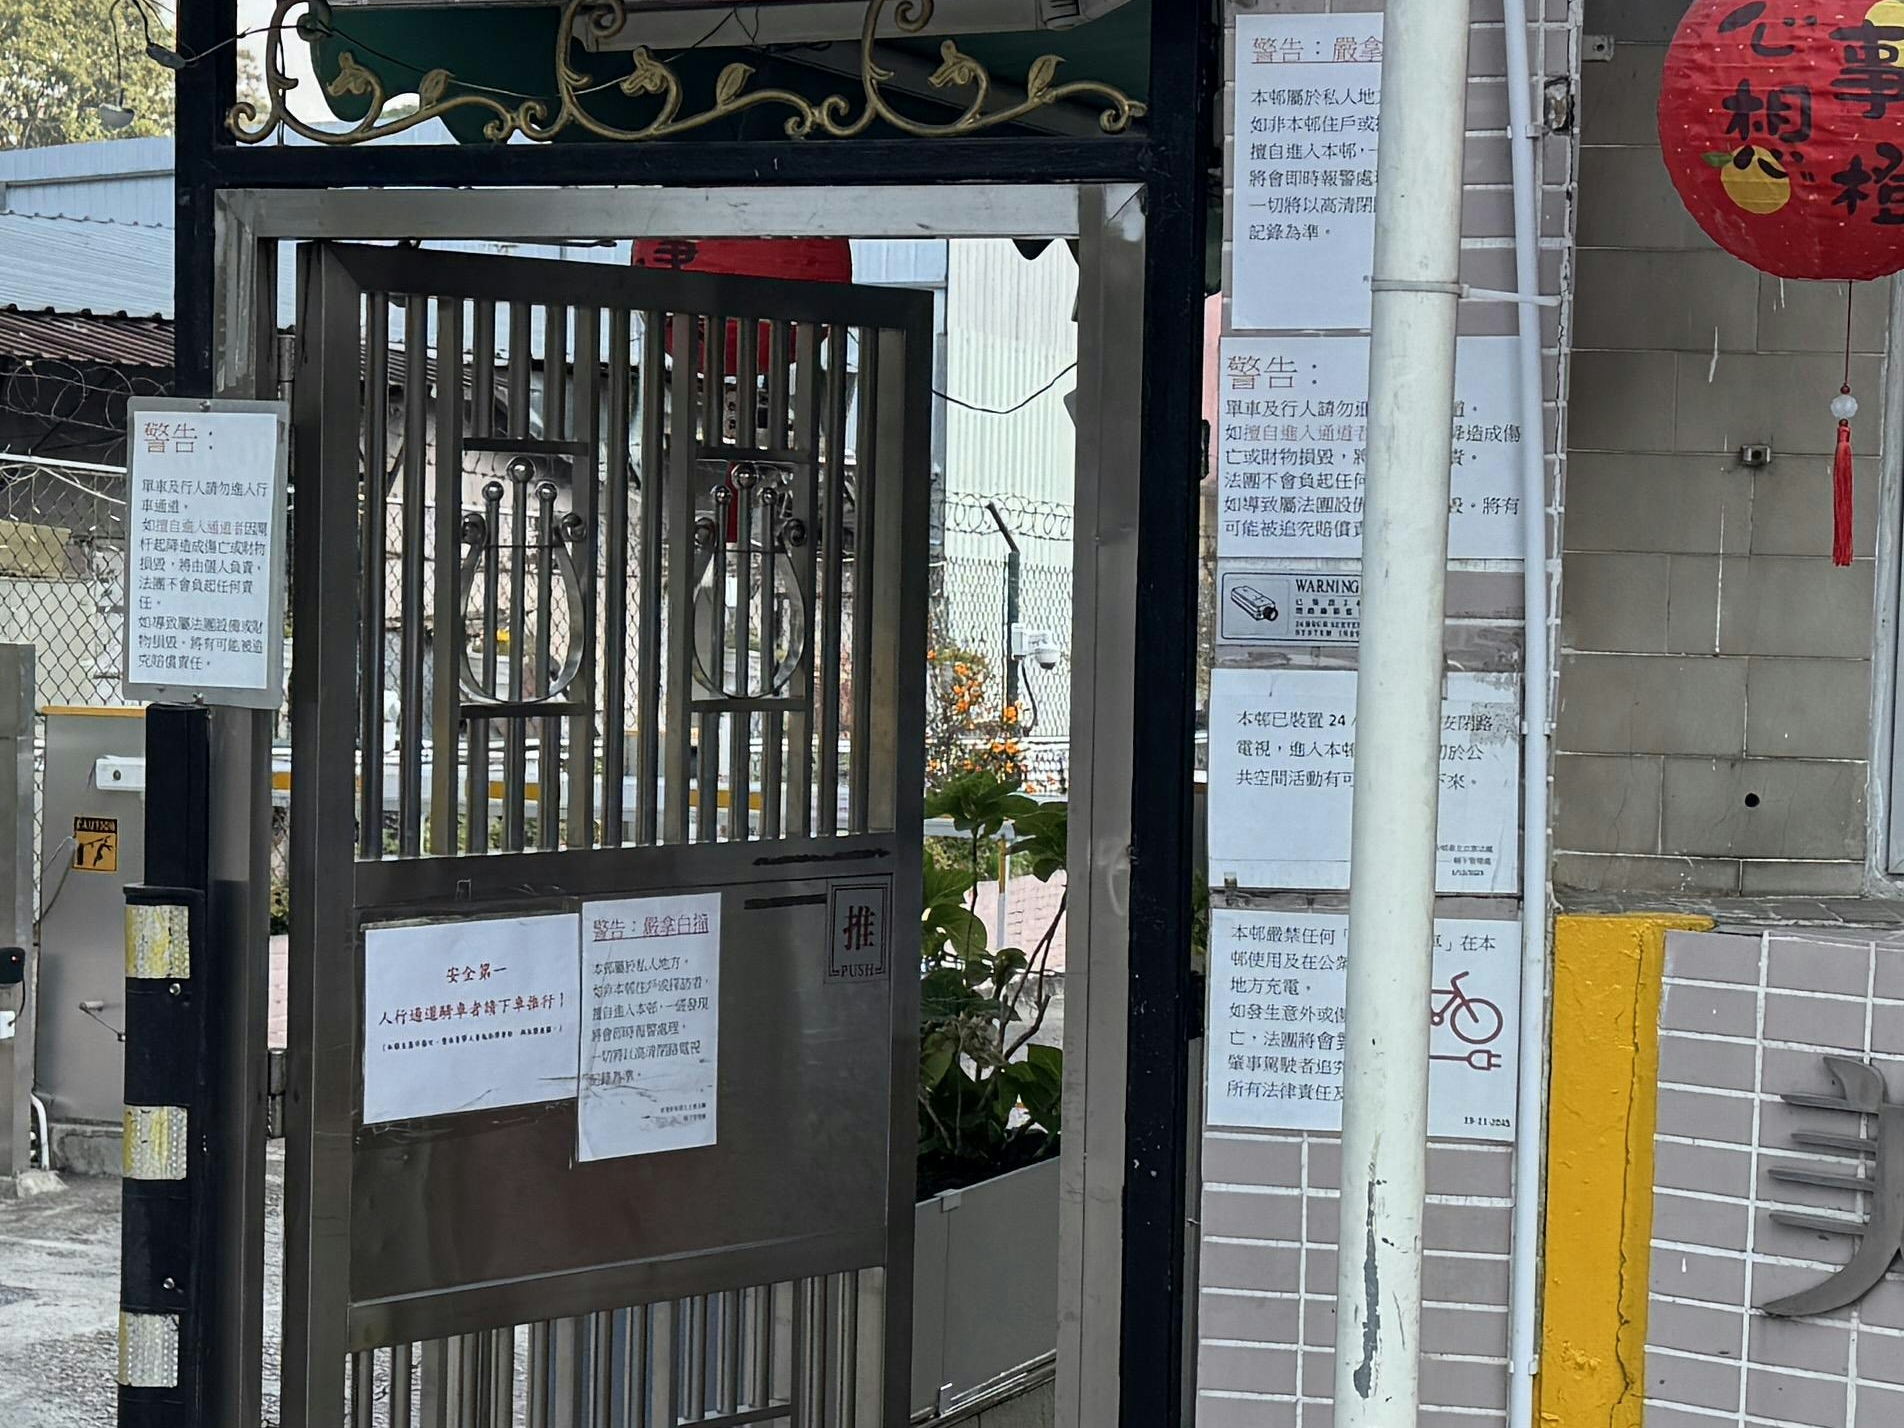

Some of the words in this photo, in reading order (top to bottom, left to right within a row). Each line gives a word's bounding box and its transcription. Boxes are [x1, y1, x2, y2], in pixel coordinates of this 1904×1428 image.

[1250, 88, 1381, 106] 本邨屬於私人地
[1250, 115, 1379, 133] 如非本邨住戶或
[1249, 169, 1378, 187] 將會即時報警處
[1248, 196, 1376, 214] 一切將以高清閉
[1226, 356, 1317, 390] 警告：
[144, 422, 213, 453] 警告：
[1296, 579, 1359, 593] WARNING
[1328, 715, 1346, 727] 24
[843, 905, 876, 951] 推
[446, 963, 507, 984] 安全第一
[841, 963, 874, 977] PUSH
